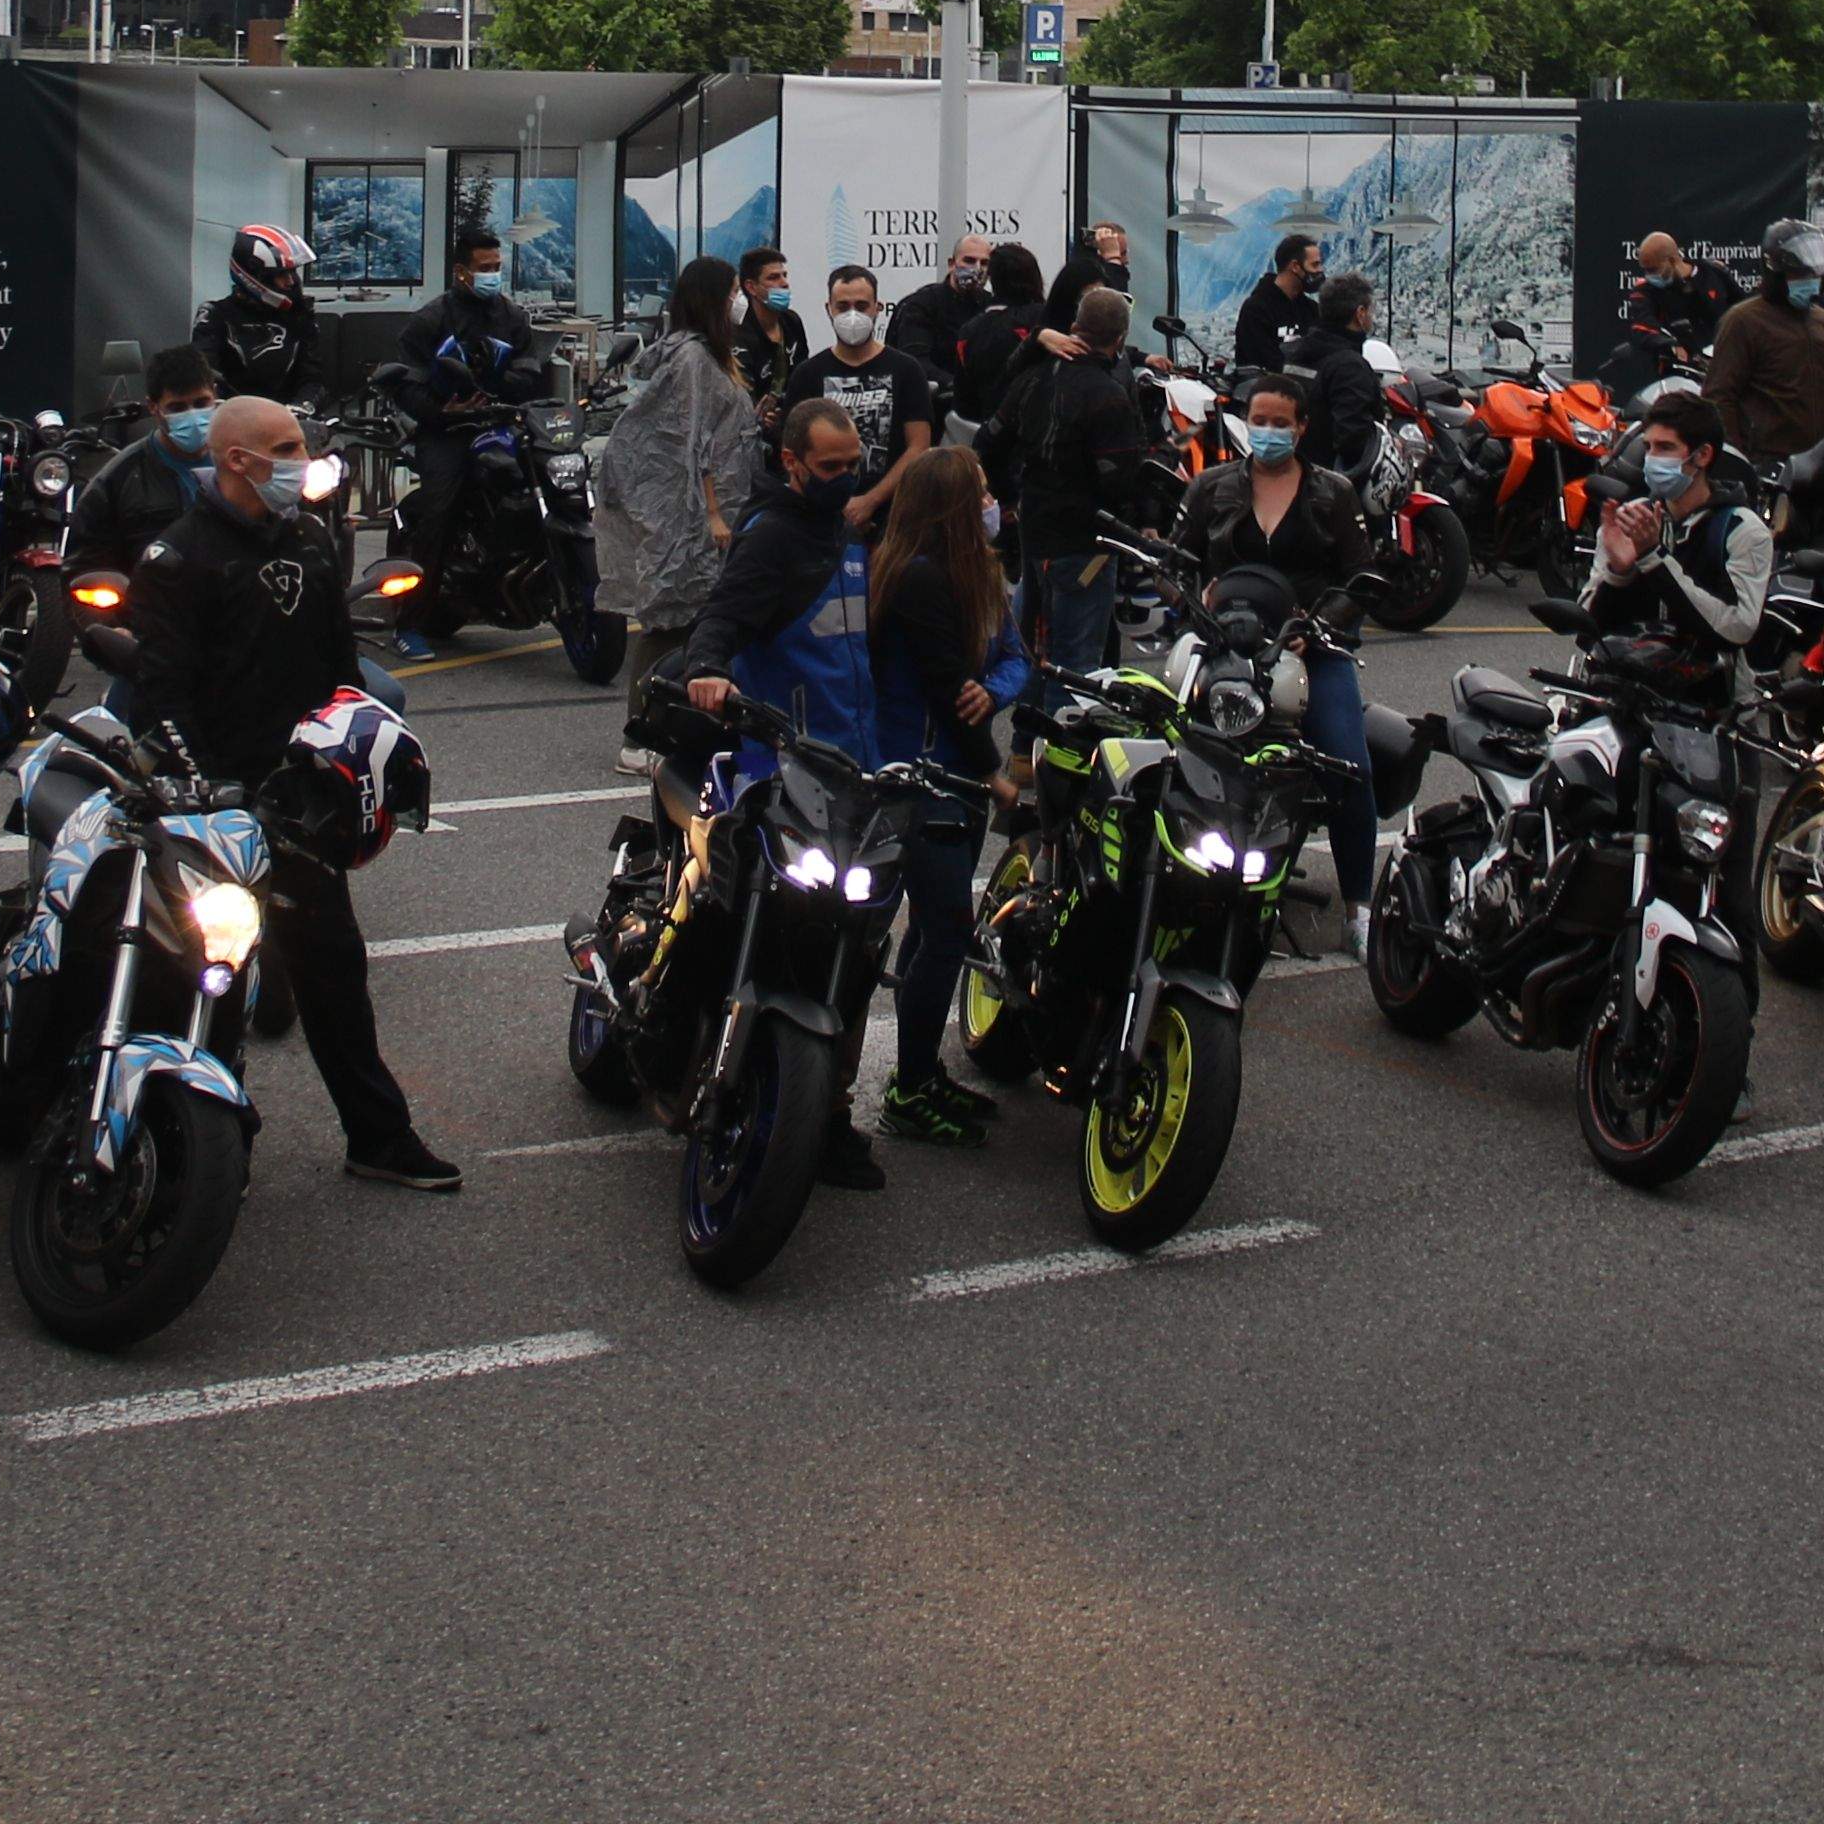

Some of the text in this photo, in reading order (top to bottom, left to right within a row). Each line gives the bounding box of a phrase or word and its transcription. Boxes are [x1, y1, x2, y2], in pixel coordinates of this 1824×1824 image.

[1036, 10, 1055, 39] P
[1250, 66, 1264, 88] P
[357, 774, 376, 834] HJC
